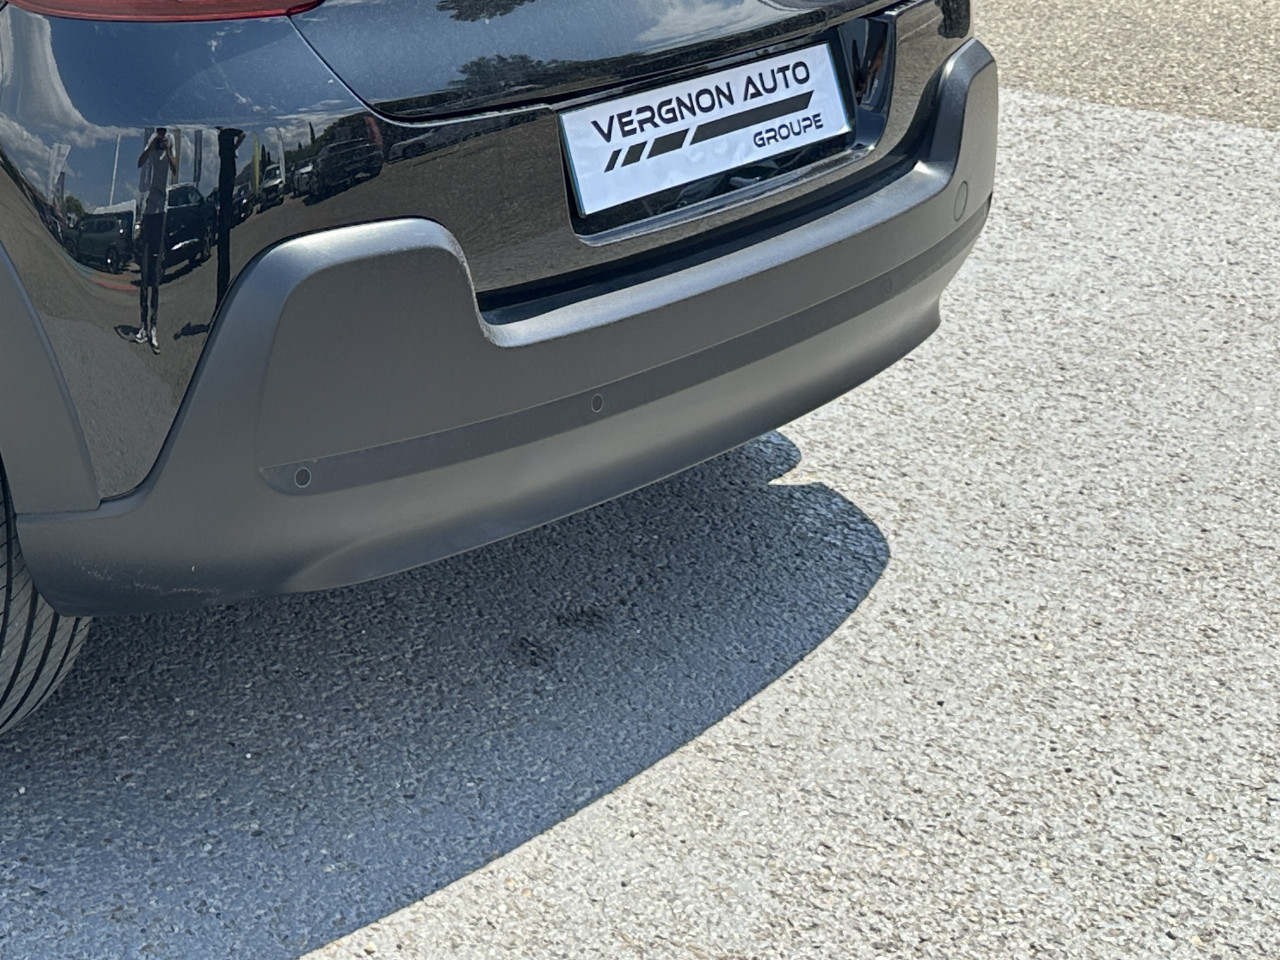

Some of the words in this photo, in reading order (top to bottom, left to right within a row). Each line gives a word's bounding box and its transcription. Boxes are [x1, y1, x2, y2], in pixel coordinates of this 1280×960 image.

[590, 81, 735, 143] VERGNON
[742, 60, 811, 102] AUTO
[752, 112, 824, 148] GROUPE
